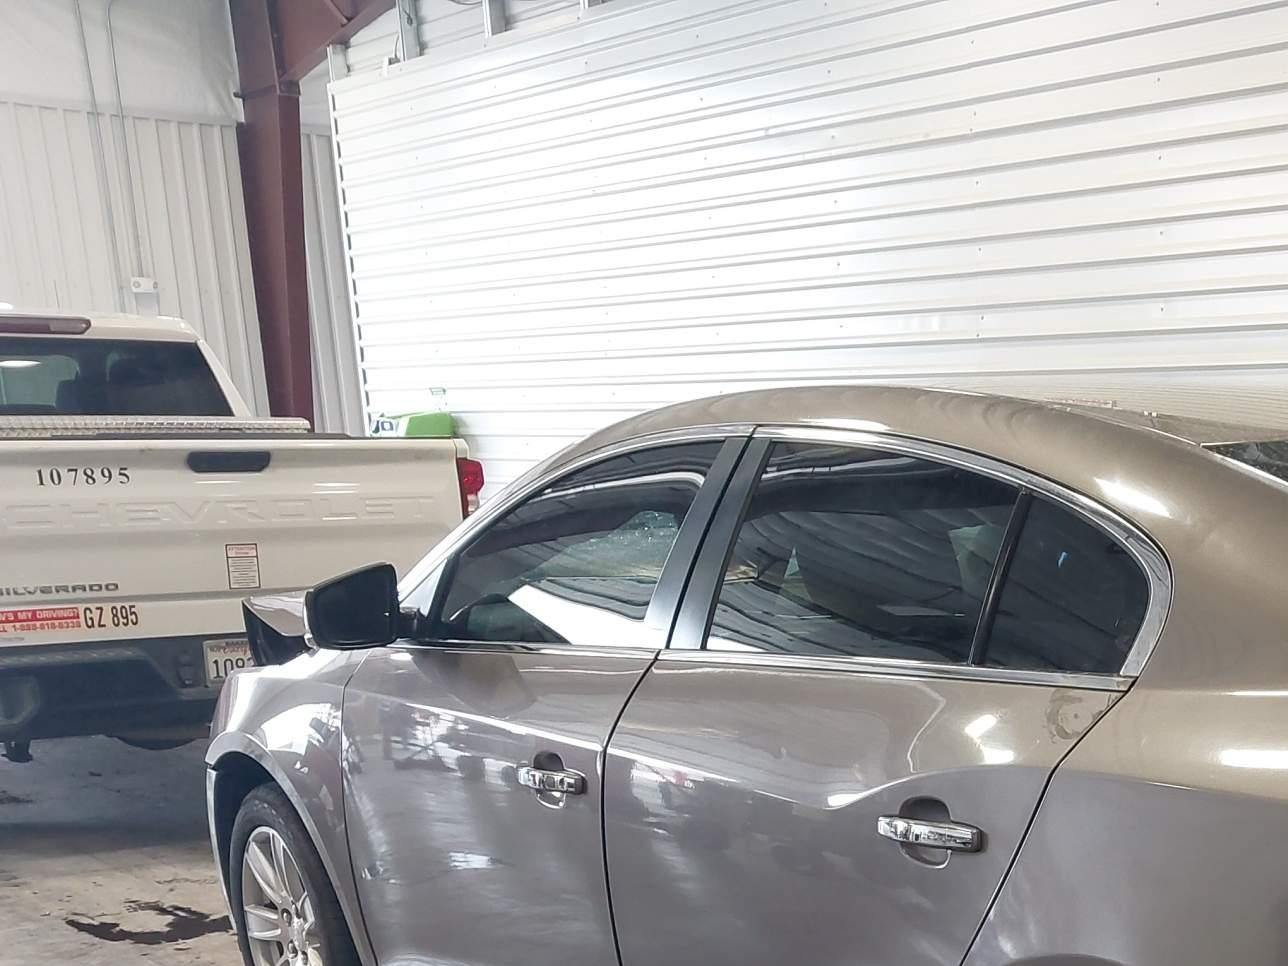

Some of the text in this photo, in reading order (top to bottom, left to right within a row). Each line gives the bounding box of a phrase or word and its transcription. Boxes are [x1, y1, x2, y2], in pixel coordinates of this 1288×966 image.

[36, 466, 130, 486] 107895
[3, 495, 434, 528] CHEVROLET
[17, 611, 32, 620] MY
[36, 608, 78, 619] DRIVING?
[83, 605, 139, 629] GZ 895
